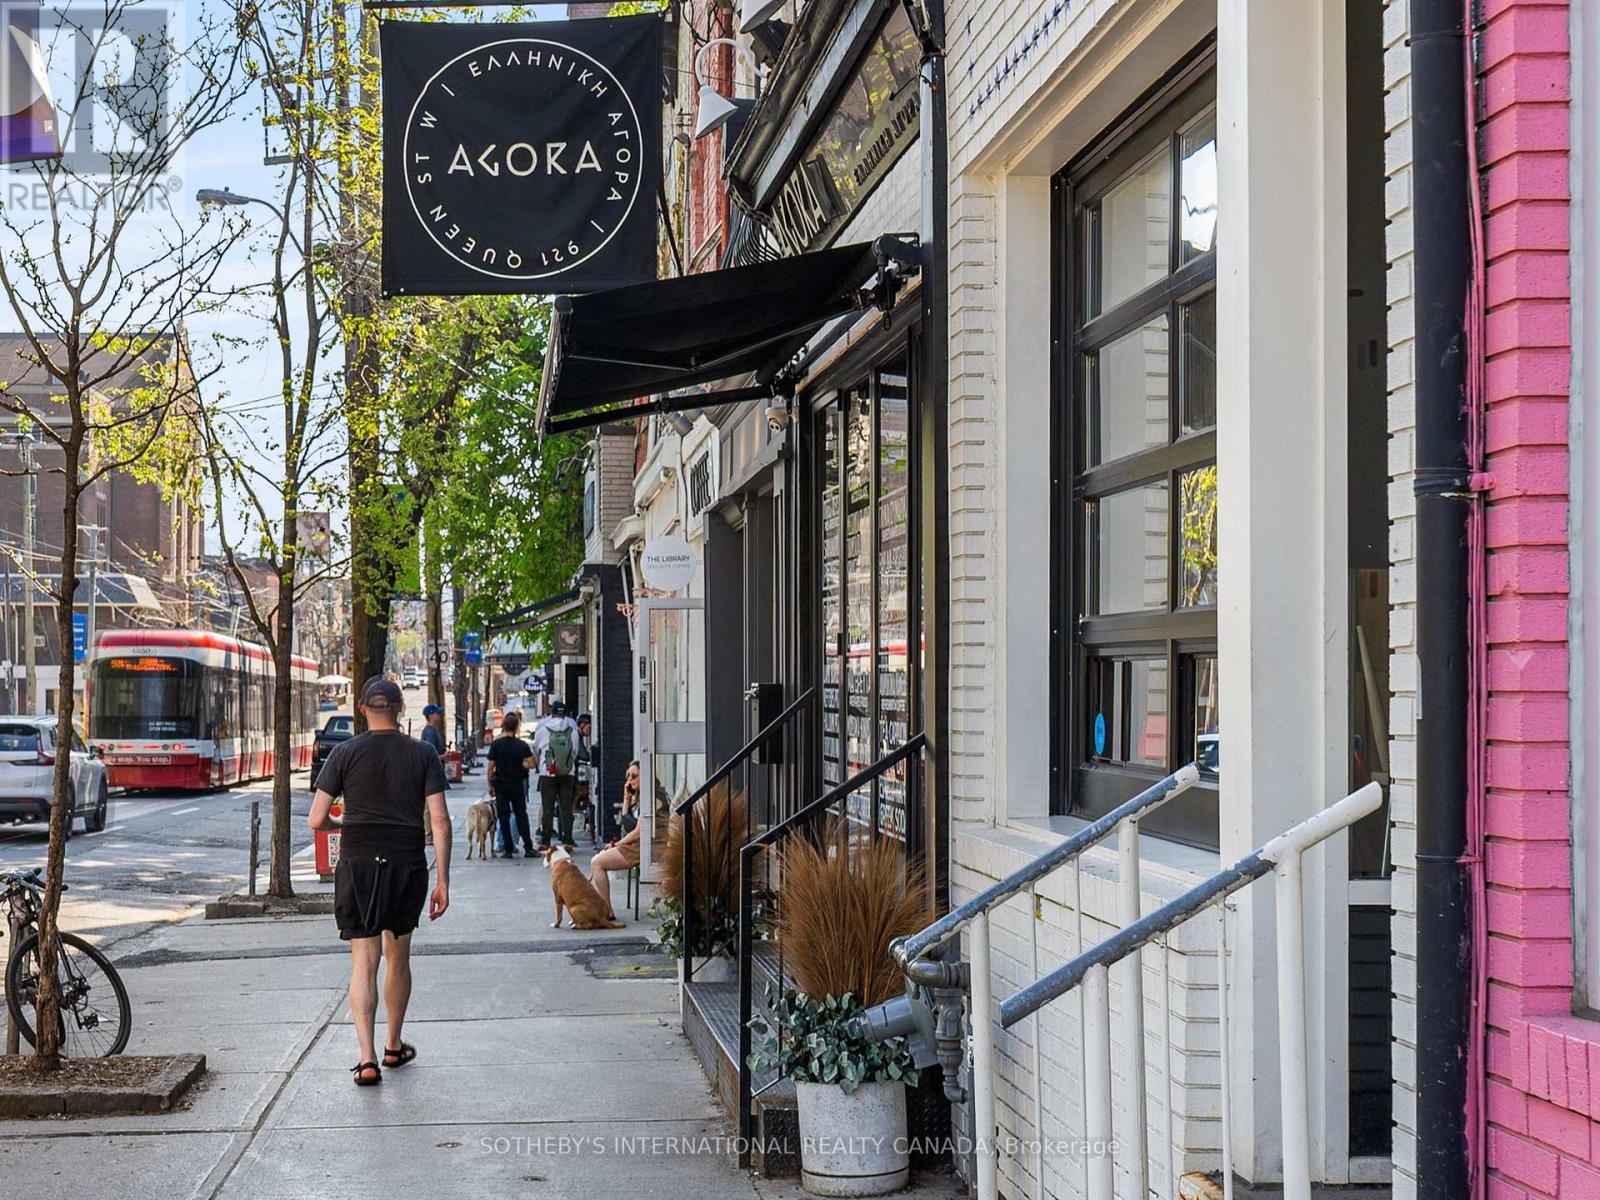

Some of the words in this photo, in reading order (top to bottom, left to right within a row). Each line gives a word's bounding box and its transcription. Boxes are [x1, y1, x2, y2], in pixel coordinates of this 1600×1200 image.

[419, 110, 438, 129] W
[415, 152, 432, 184] ST
[447, 140, 602, 177] AGORA
[429, 204, 522, 269] QUEEN
[541, 240, 579, 266] 921
[647, 555, 660, 563] THE
[661, 554, 690, 562] LIBRARY
[430, 650, 448, 664] 40
